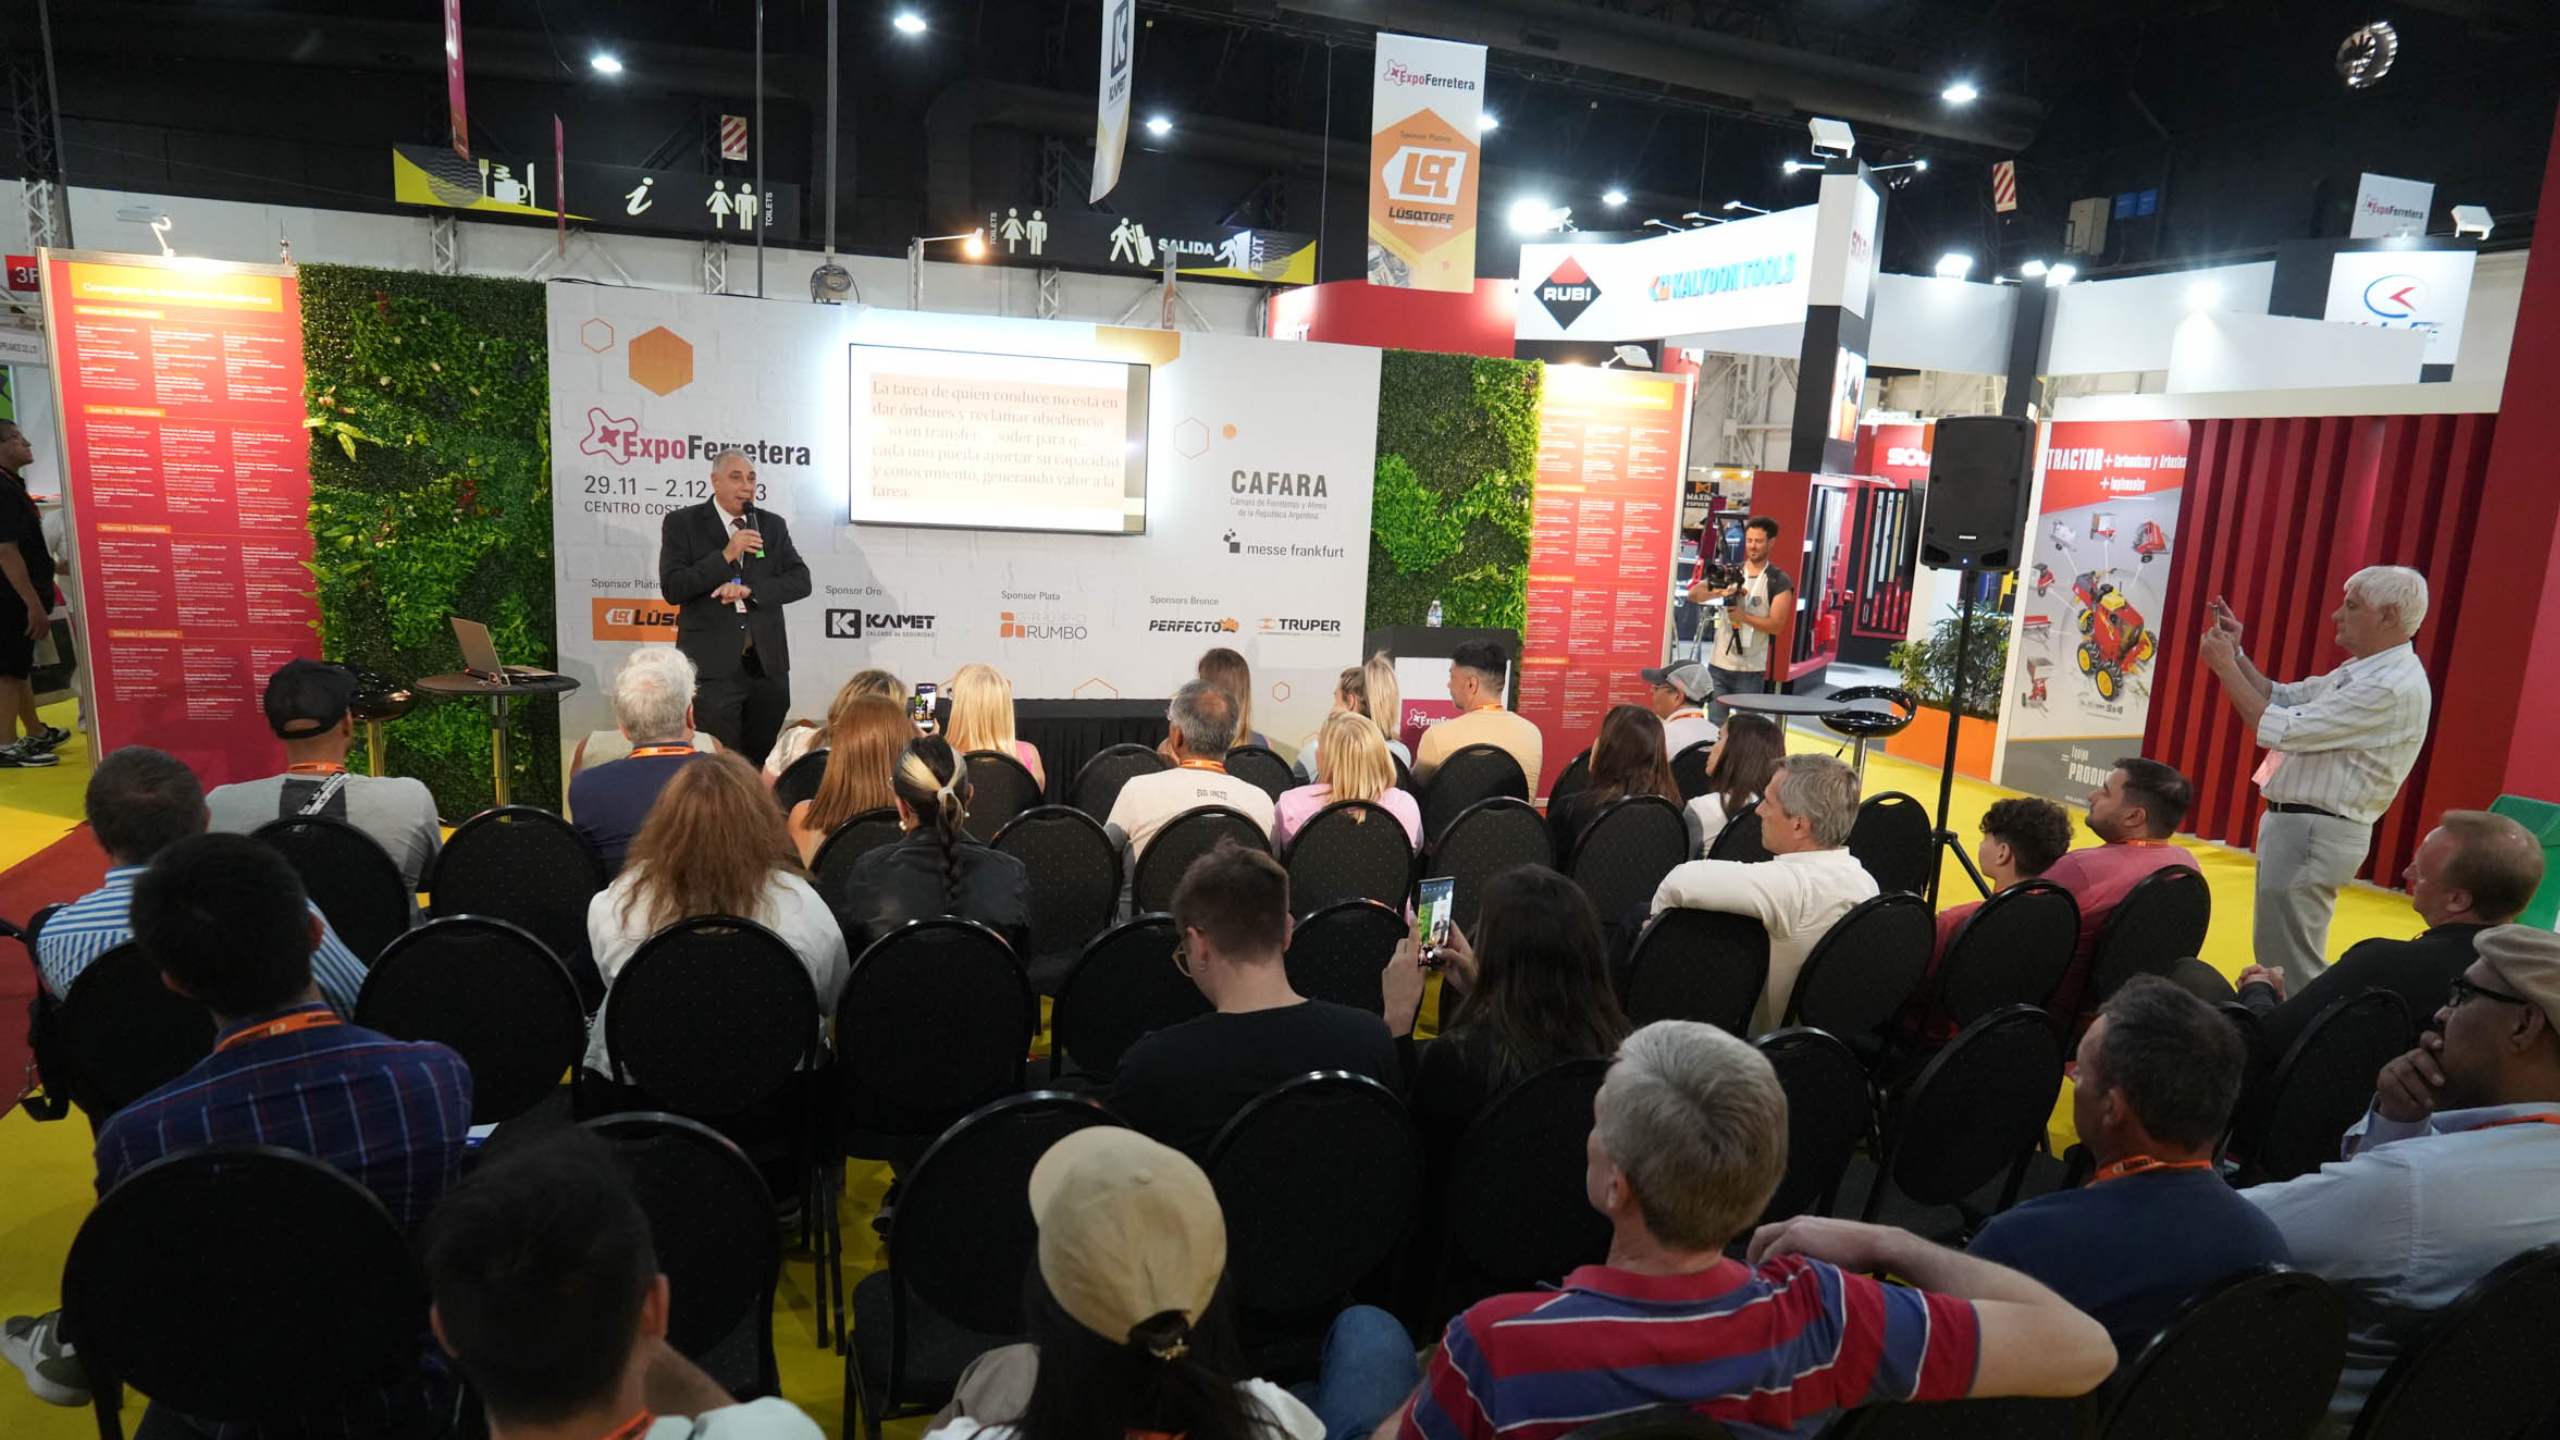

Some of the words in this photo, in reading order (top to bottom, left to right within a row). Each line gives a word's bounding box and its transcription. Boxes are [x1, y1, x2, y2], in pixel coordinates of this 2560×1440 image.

[1399, 70, 1475, 91] ExpoFerretera
[765, 192, 773, 227] TOILETS
[2372, 203, 2424, 220] ExpoFerretera
[1158, 238, 1215, 256] SALIDA
[1250, 236, 1265, 272] EXIT
[1672, 262, 1742, 299] KALYDON
[1743, 252, 1796, 289] TOOLS
[1543, 286, 1592, 301] RUBI
[872, 381, 888, 395] La
[893, 384, 928, 398] tarea
[931, 384, 949, 398] de
[952, 386, 990, 404] quien
[994, 388, 1050, 405] conduce
[1053, 395, 1070, 406] no
[1073, 392, 1099, 408] está
[1102, 397, 1118, 409] en
[872, 401, 896, 415] dar
[900, 403, 955, 419] órdenes
[958, 410, 965, 421] y
[970, 408, 1029, 424] reclamar
[1033, 411, 1104, 428] obediencia
[1036, 433, 1066, 449] para
[872, 444, 905, 459] cada
[908, 447, 935, 460] uno
[938, 446, 980, 462] pueda
[982, 450, 1034, 465] aportar
[1036, 453, 1052, 465] su
[1055, 453, 1120, 470] capacidad
[2047, 448, 2104, 470] TRACTOR
[584, 475, 637, 495] 29.11
[872, 466, 880, 479] y
[883, 466, 979, 483] conocimiento,
[983, 470, 1053, 486] generando
[1056, 473, 1088, 487] valor
[1103, 476, 1115, 488] la
[1231, 470, 1328, 498] CAFARA
[584, 501, 640, 515] CENTRO
[1257, 499, 1265, 507] de
[1288, 512, 1319, 521] Argentina
[1247, 546, 1287, 556] messe
[1291, 543, 1345, 558] frankfurt
[591, 579, 632, 590] Sponsor
[826, 585, 863, 597] Sponsor
[866, 586, 882, 596] Oro
[1001, 590, 1037, 601] Sponsor
[1039, 592, 1061, 601] Plata
[1150, 595, 1188, 607] Sponsors
[1190, 596, 1219, 606] Bronce
[866, 614, 935, 630] KAMET
[1149, 620, 1222, 633] PERFECTO
[1279, 619, 1341, 632] TRUPER
[1027, 625, 1088, 640] RUMBO
